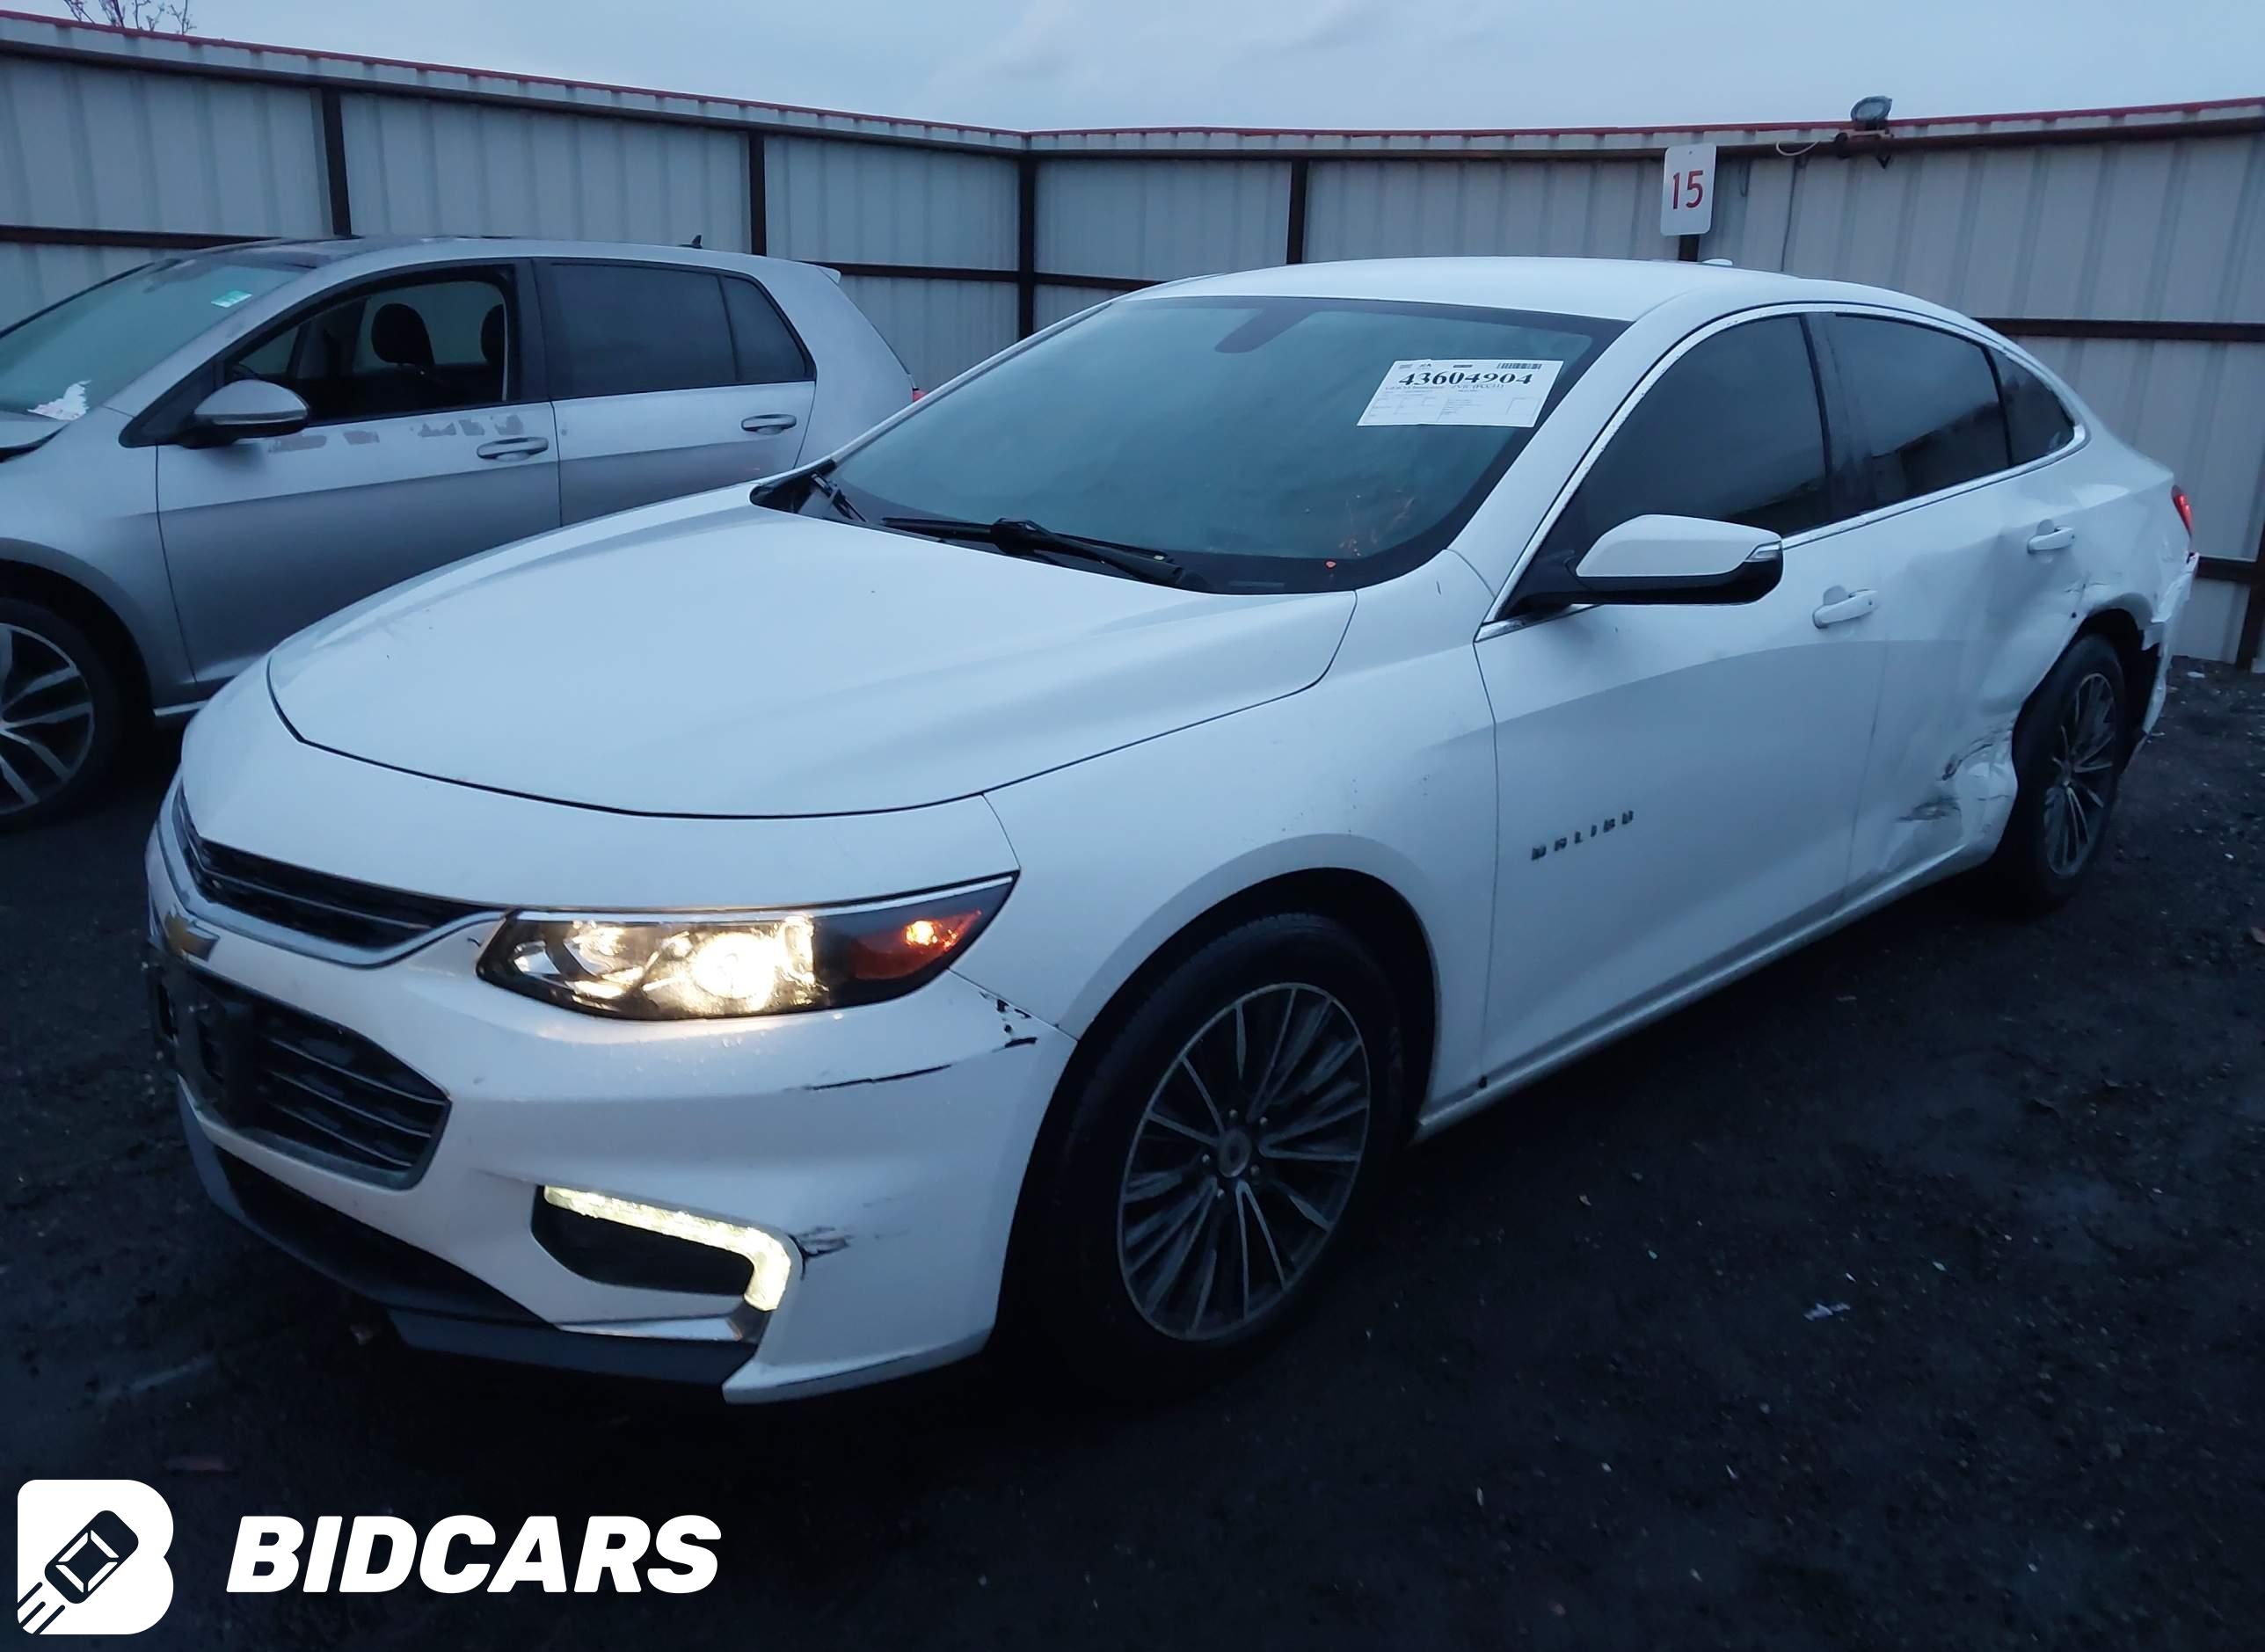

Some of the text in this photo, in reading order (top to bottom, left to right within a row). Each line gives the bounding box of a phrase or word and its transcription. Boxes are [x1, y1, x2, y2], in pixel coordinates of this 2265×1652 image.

[1672, 171, 1703, 209] 15
[1399, 371, 1533, 386] 43604904
[1531, 810, 1635, 861] MALIBU
